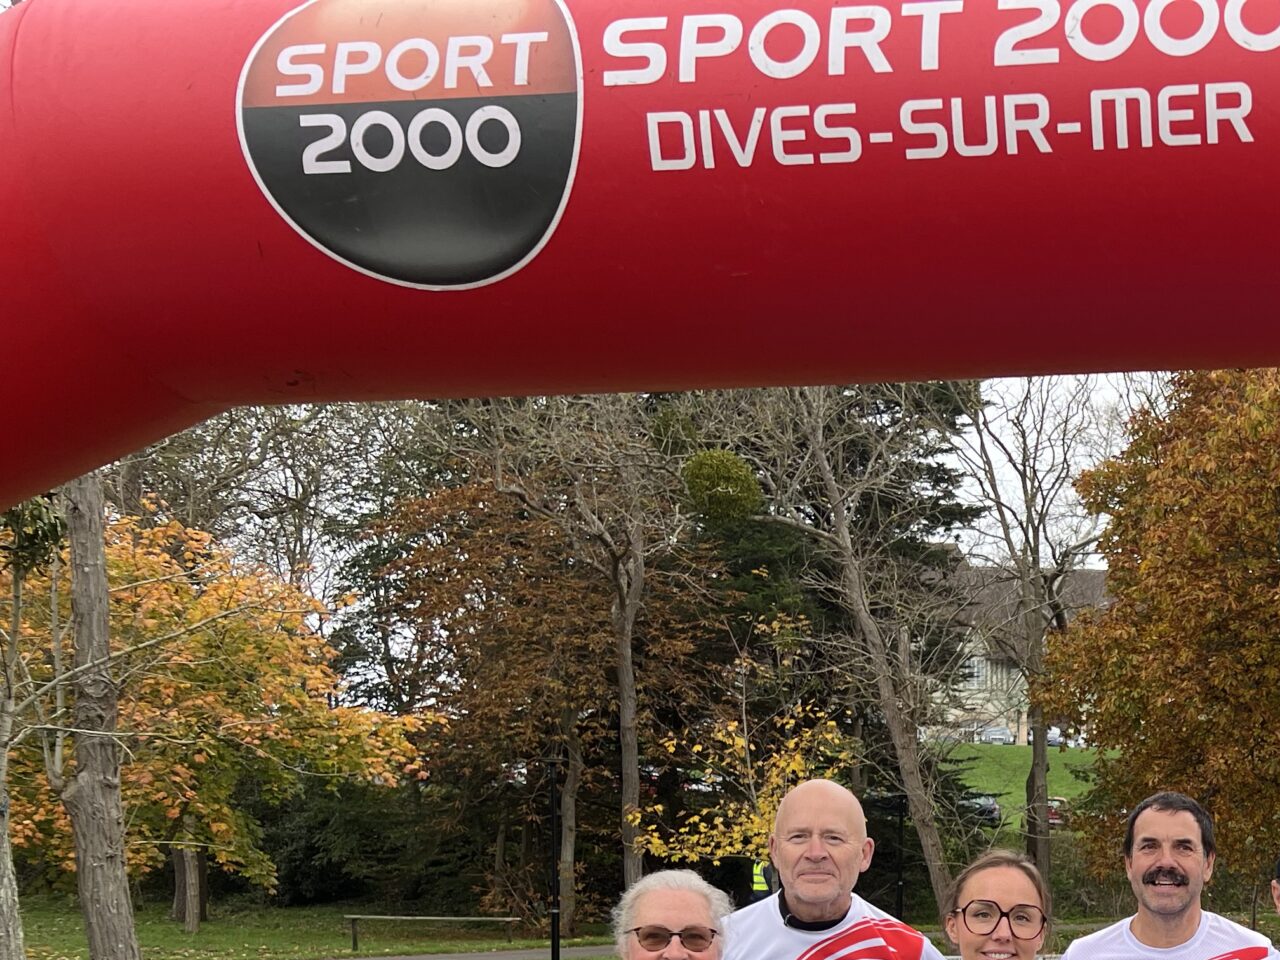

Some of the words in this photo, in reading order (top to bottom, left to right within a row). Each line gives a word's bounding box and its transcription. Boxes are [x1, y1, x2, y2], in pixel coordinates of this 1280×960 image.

[275, 32, 548, 97] SPORT
[603, 1, 963, 86] SPORT
[299, 105, 521, 174] 2000
[646, 81, 1254, 171] DIVES-SUR-MER
